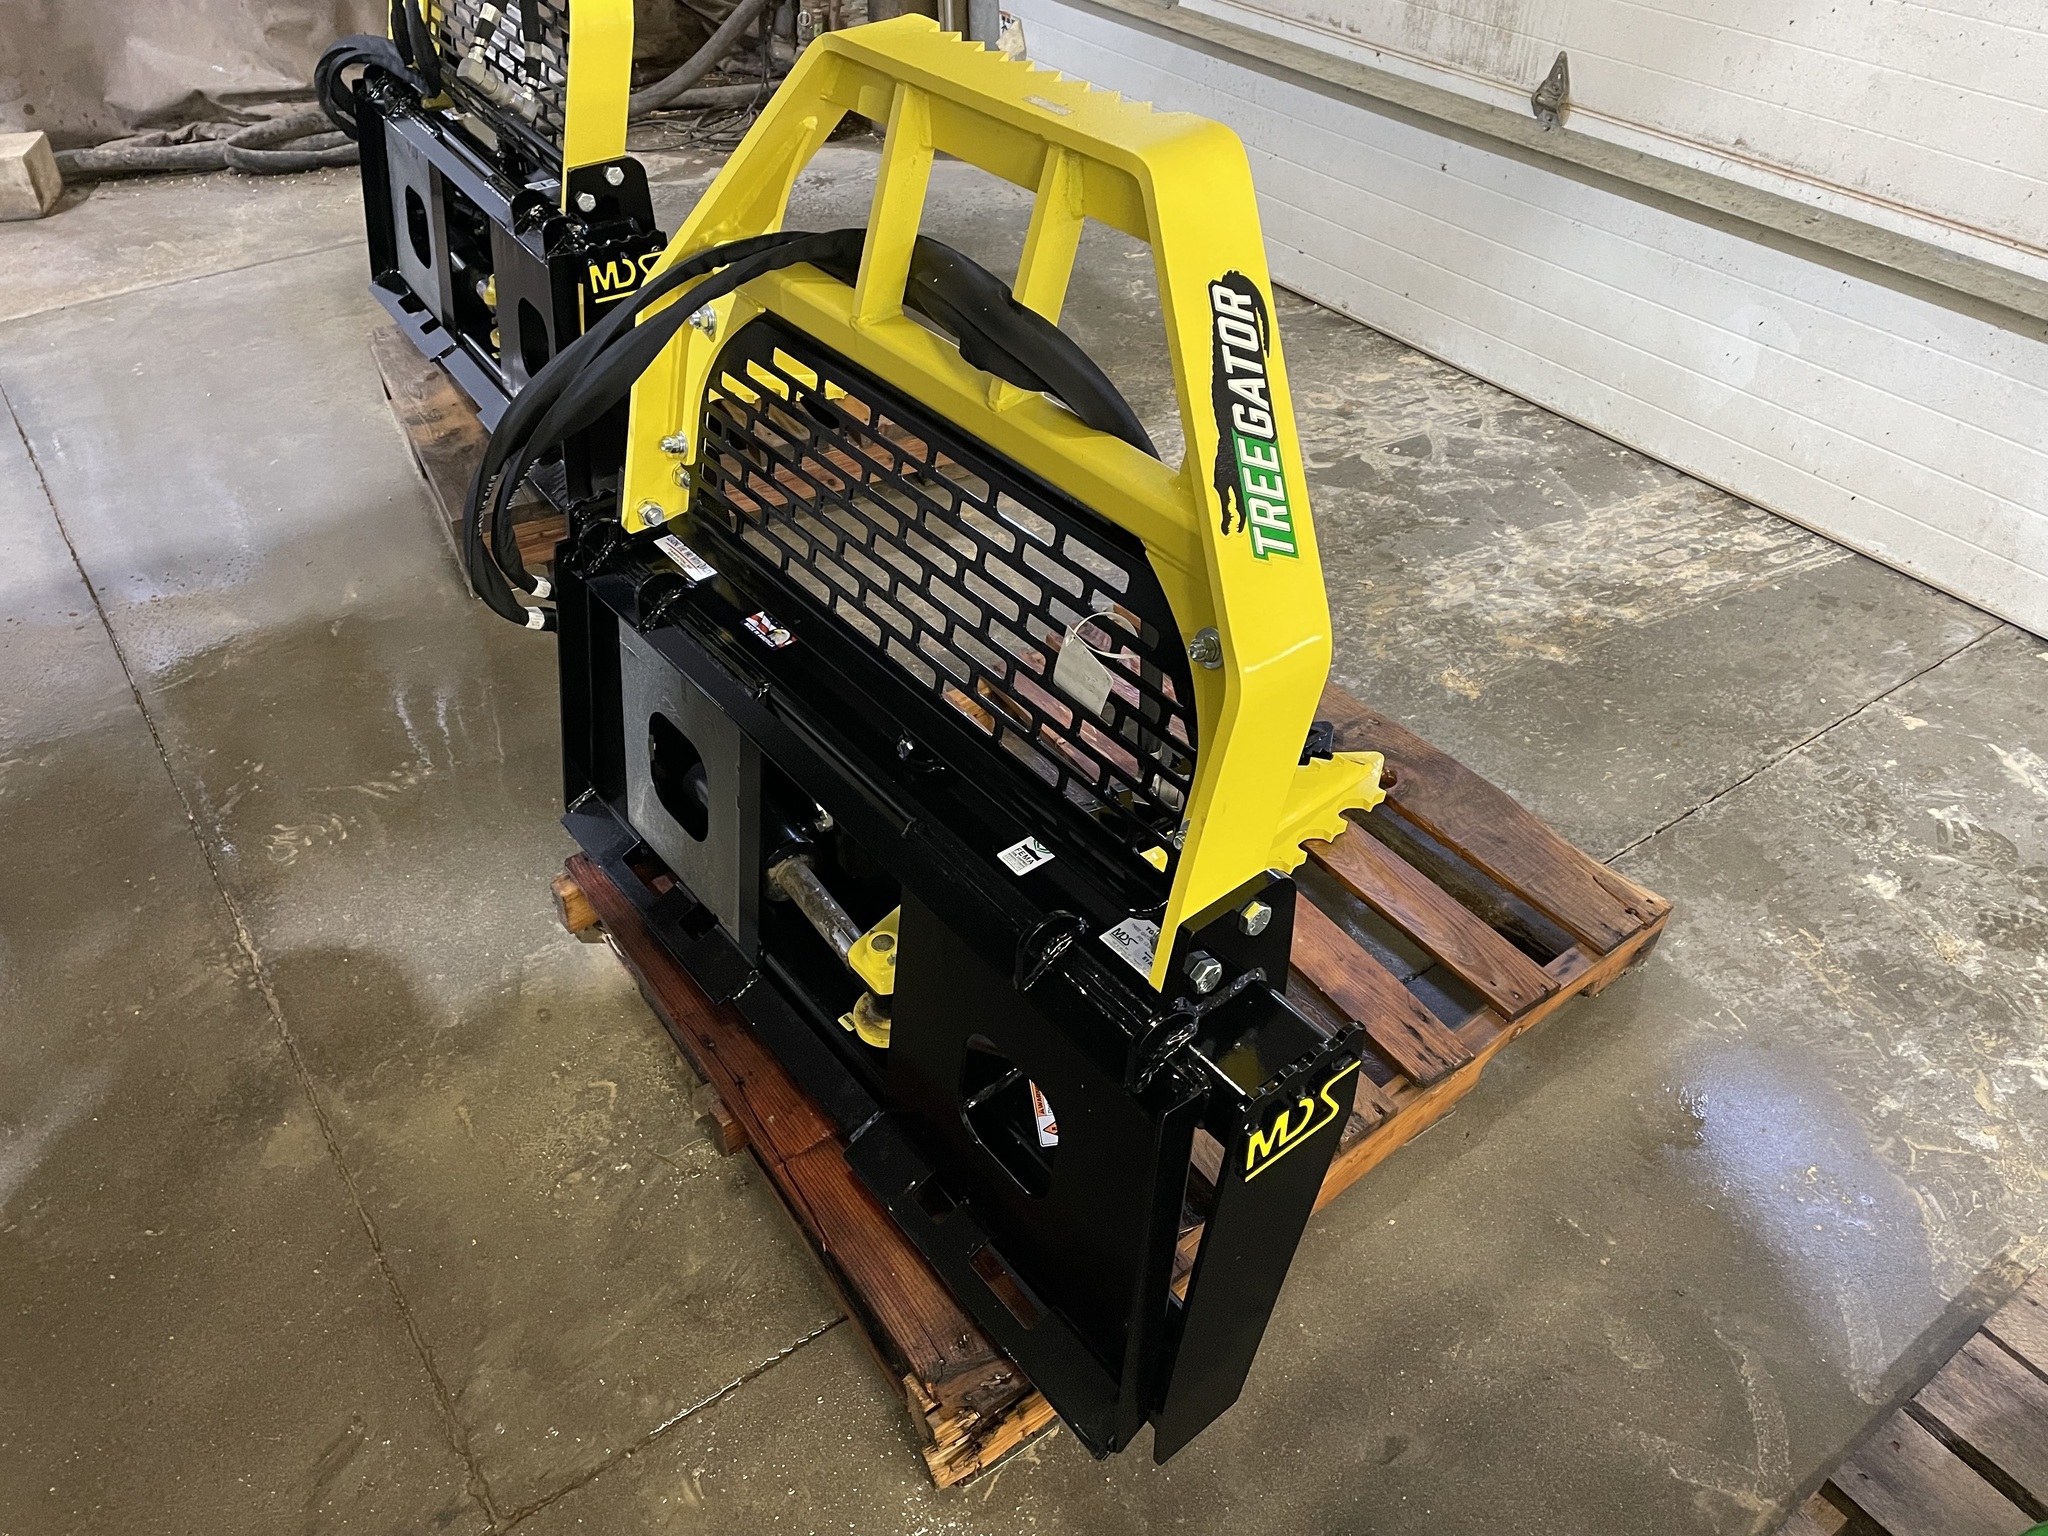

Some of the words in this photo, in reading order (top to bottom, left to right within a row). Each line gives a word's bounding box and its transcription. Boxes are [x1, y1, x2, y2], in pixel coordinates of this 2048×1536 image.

[1014, 847, 1035, 865] FEMA
[1110, 928, 1139, 946] MDS
[1245, 1060, 1361, 1182] MDS
